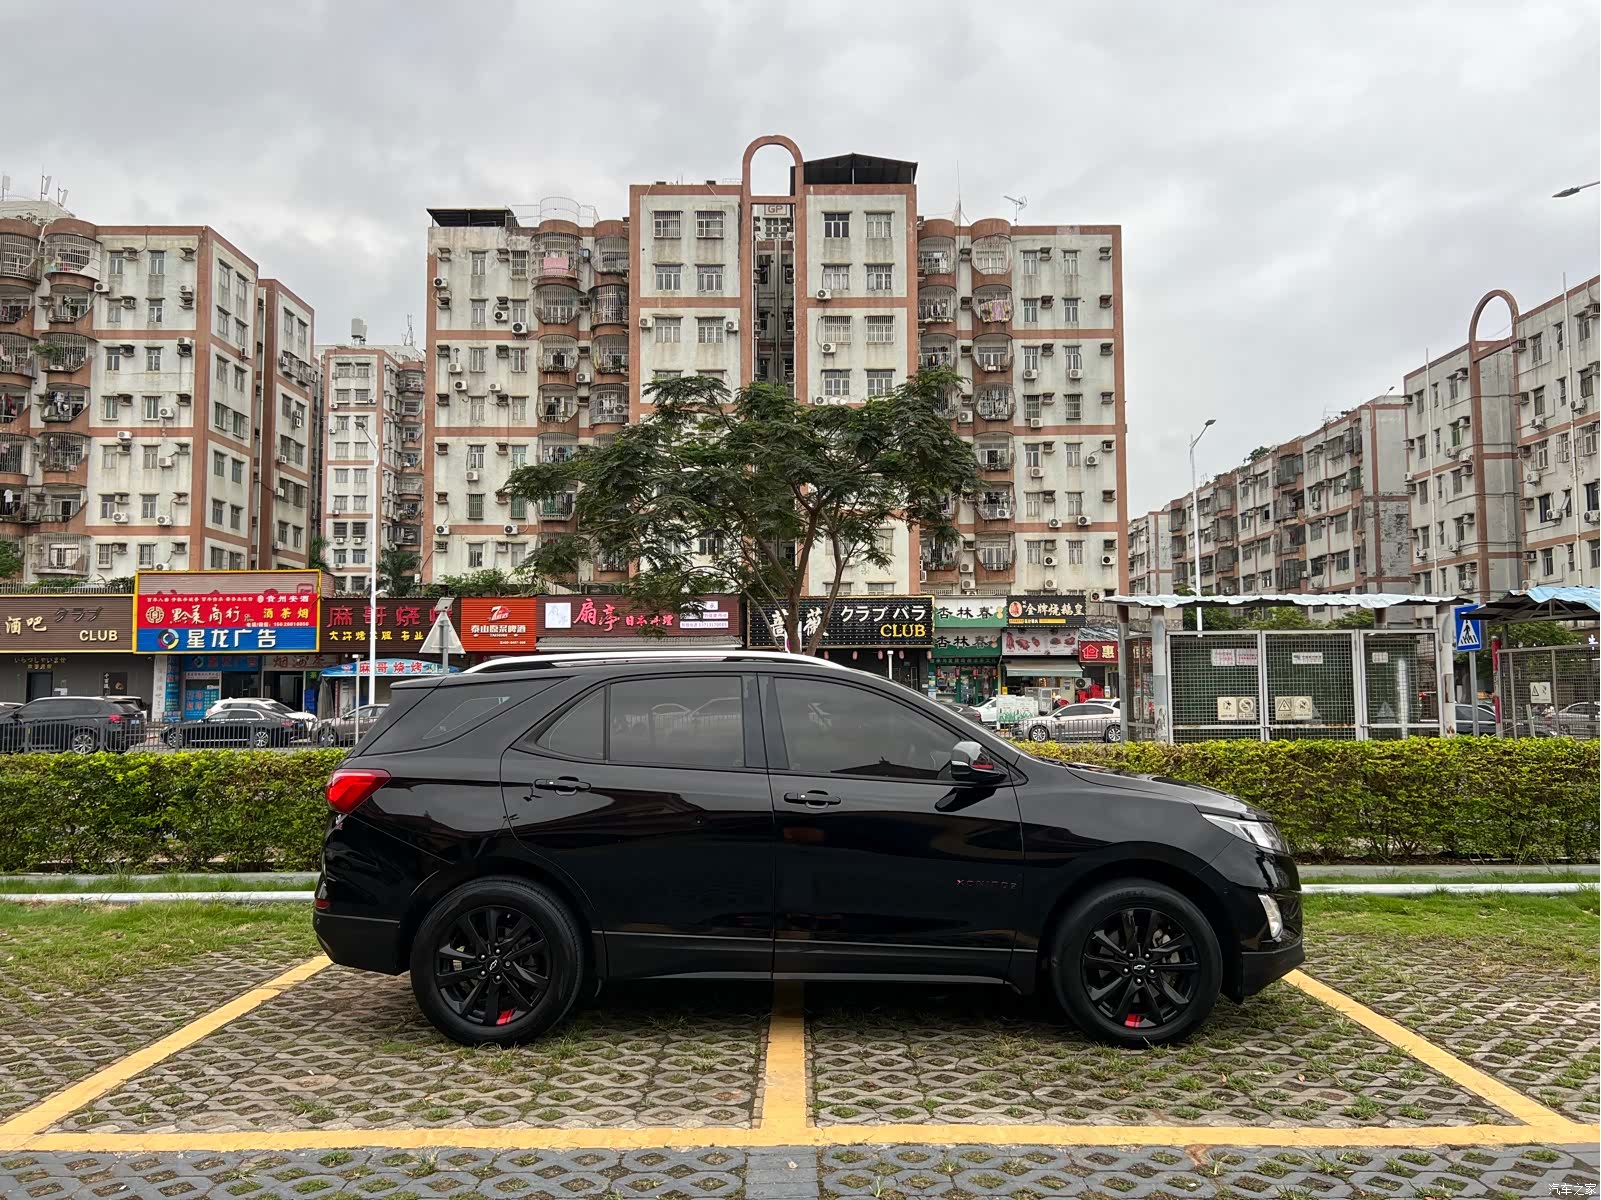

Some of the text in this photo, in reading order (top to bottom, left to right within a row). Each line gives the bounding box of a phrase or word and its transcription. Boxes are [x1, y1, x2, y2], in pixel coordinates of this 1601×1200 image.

[768, 205, 783, 213] GP
[263, 608, 309, 619] 酒茶烟
[326, 605, 453, 627] 麻哥烧
[937, 606, 992, 620] 杏林春
[5, 616, 47, 635] 酒吧
[880, 624, 926, 637] CLUB
[80, 630, 118, 641] CLUB
[187, 629, 276, 648] 星龙广告
[936, 636, 991, 649] 杏林春
